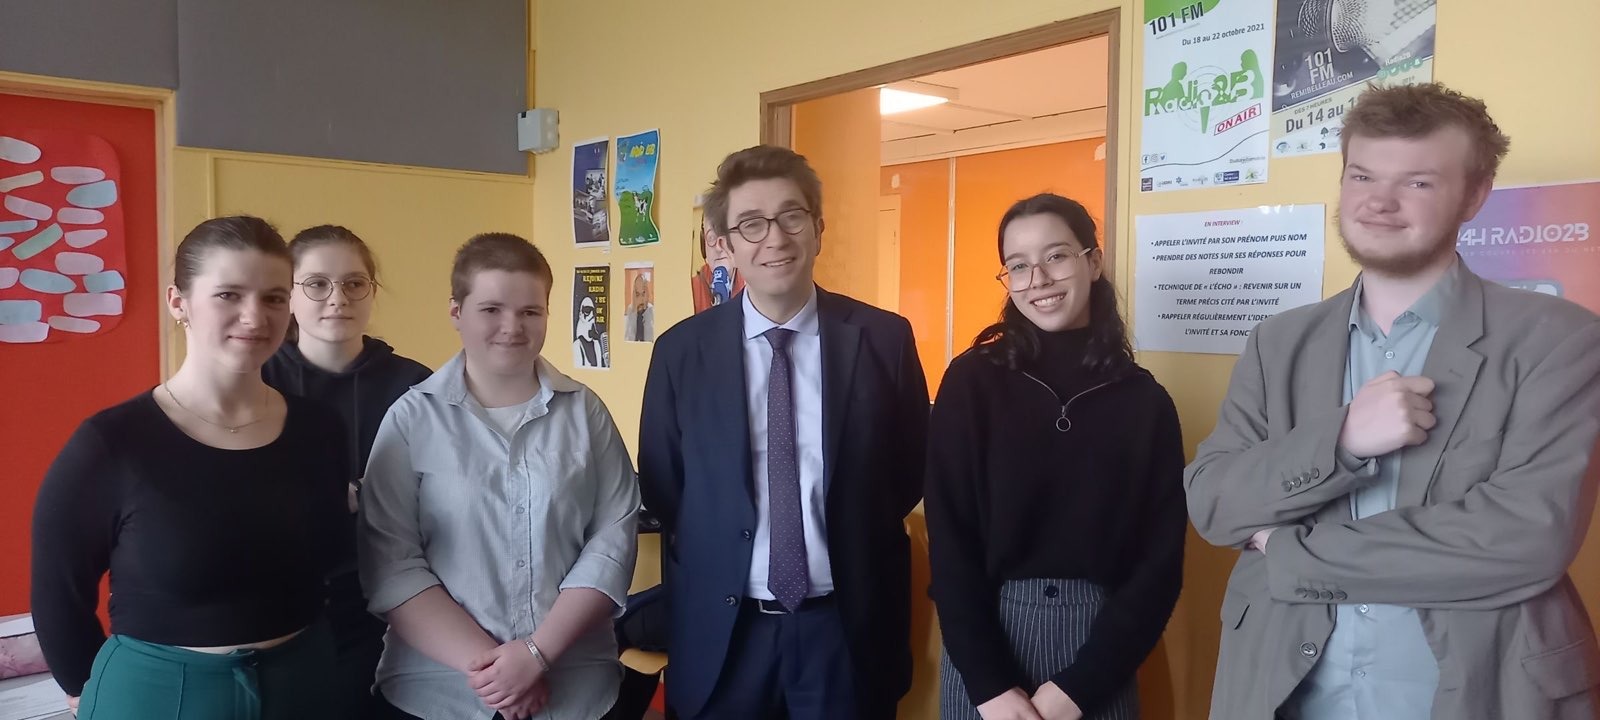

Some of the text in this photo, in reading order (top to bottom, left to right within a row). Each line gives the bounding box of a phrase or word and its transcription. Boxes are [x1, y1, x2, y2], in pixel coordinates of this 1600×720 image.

[1149, 1, 1204, 36] 101 FM
[1182, 38, 1191, 46] Du
[1193, 36, 1201, 44] 18
[1212, 32, 1220, 41] 22
[1221, 27, 1245, 39] octobre
[1247, 23, 1265, 33] 2021
[1304, 47, 1333, 71] 101
[1309, 63, 1335, 84] FM
[1290, 71, 1354, 100] REMIBELLEAU.COM
[1217, 106, 1257, 133] ON AIR
[1286, 118, 1303, 133] Du
[1307, 107, 1324, 126] 14
[1327, 104, 1344, 119] au
[1213, 219, 1241, 227] INTERVIEW
[1154, 233, 1307, 247] APPELER L'INVITÉ PAR SON PRÉNOM PUIS NOM
[1491, 222, 1589, 245] RADIO2B
[1156, 254, 1184, 262] PRENDRE
[1198, 252, 1219, 260] NOTES
[1235, 251, 1247, 259] SES
[1248, 248, 1284, 258] RÉPONSES
[1209, 267, 1244, 275] REBONDIR
[1157, 283, 1193, 291] TECHNIQUE
[1209, 280, 1232, 290] L'ÉCHO
[1290, 282, 1301, 290] UN
[1198, 296, 1220, 305] PRÉCIS
[1220, 296, 1235, 305] CITÉ
[1236, 298, 1250, 306] PAR
[1250, 296, 1279, 306] L'INVITÉ
[1192, 312, 1246, 321] RÉGULIÈREMENT
[1185, 327, 1210, 336] L'INVITÉ
[1229, 329, 1250, 337] FONC
